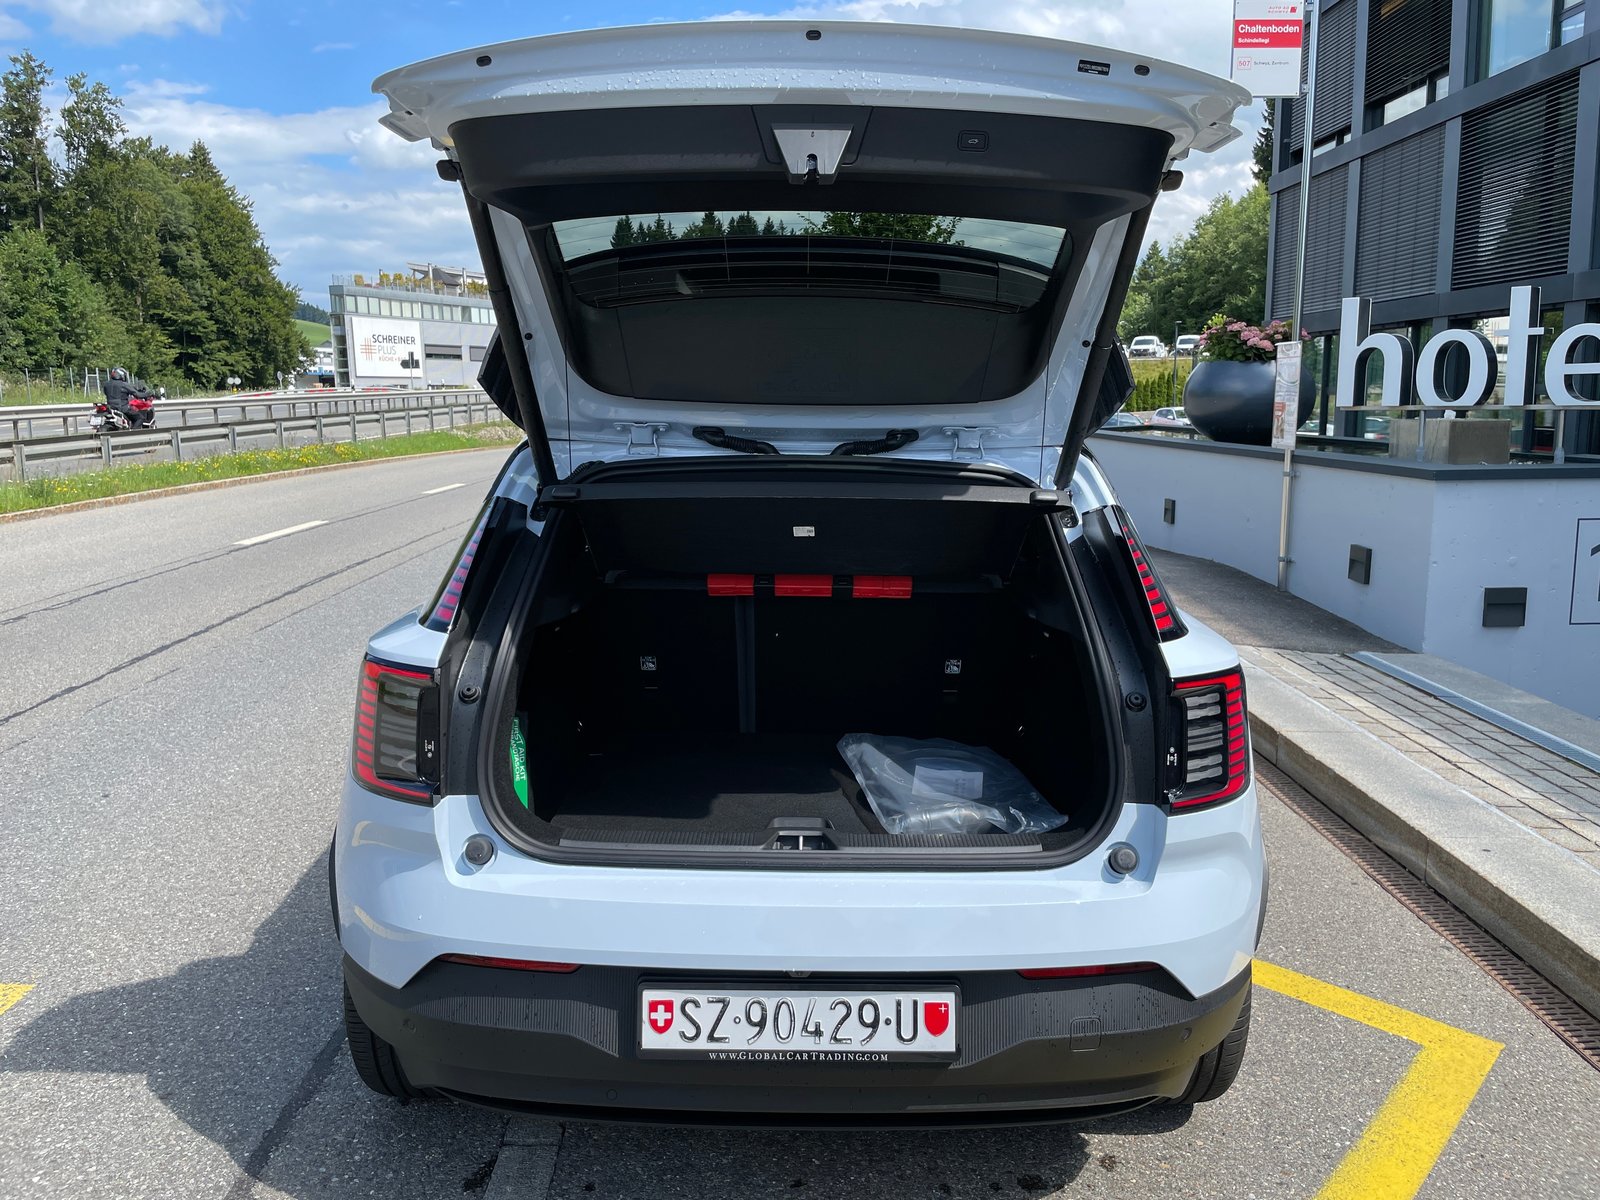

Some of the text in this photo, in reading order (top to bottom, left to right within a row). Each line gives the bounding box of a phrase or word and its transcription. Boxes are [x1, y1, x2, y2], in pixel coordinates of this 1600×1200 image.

[1238, 24, 1299, 33] Chaltenboden
[372, 334, 416, 345] SCHREINER
[378, 345, 396, 355] PLUS
